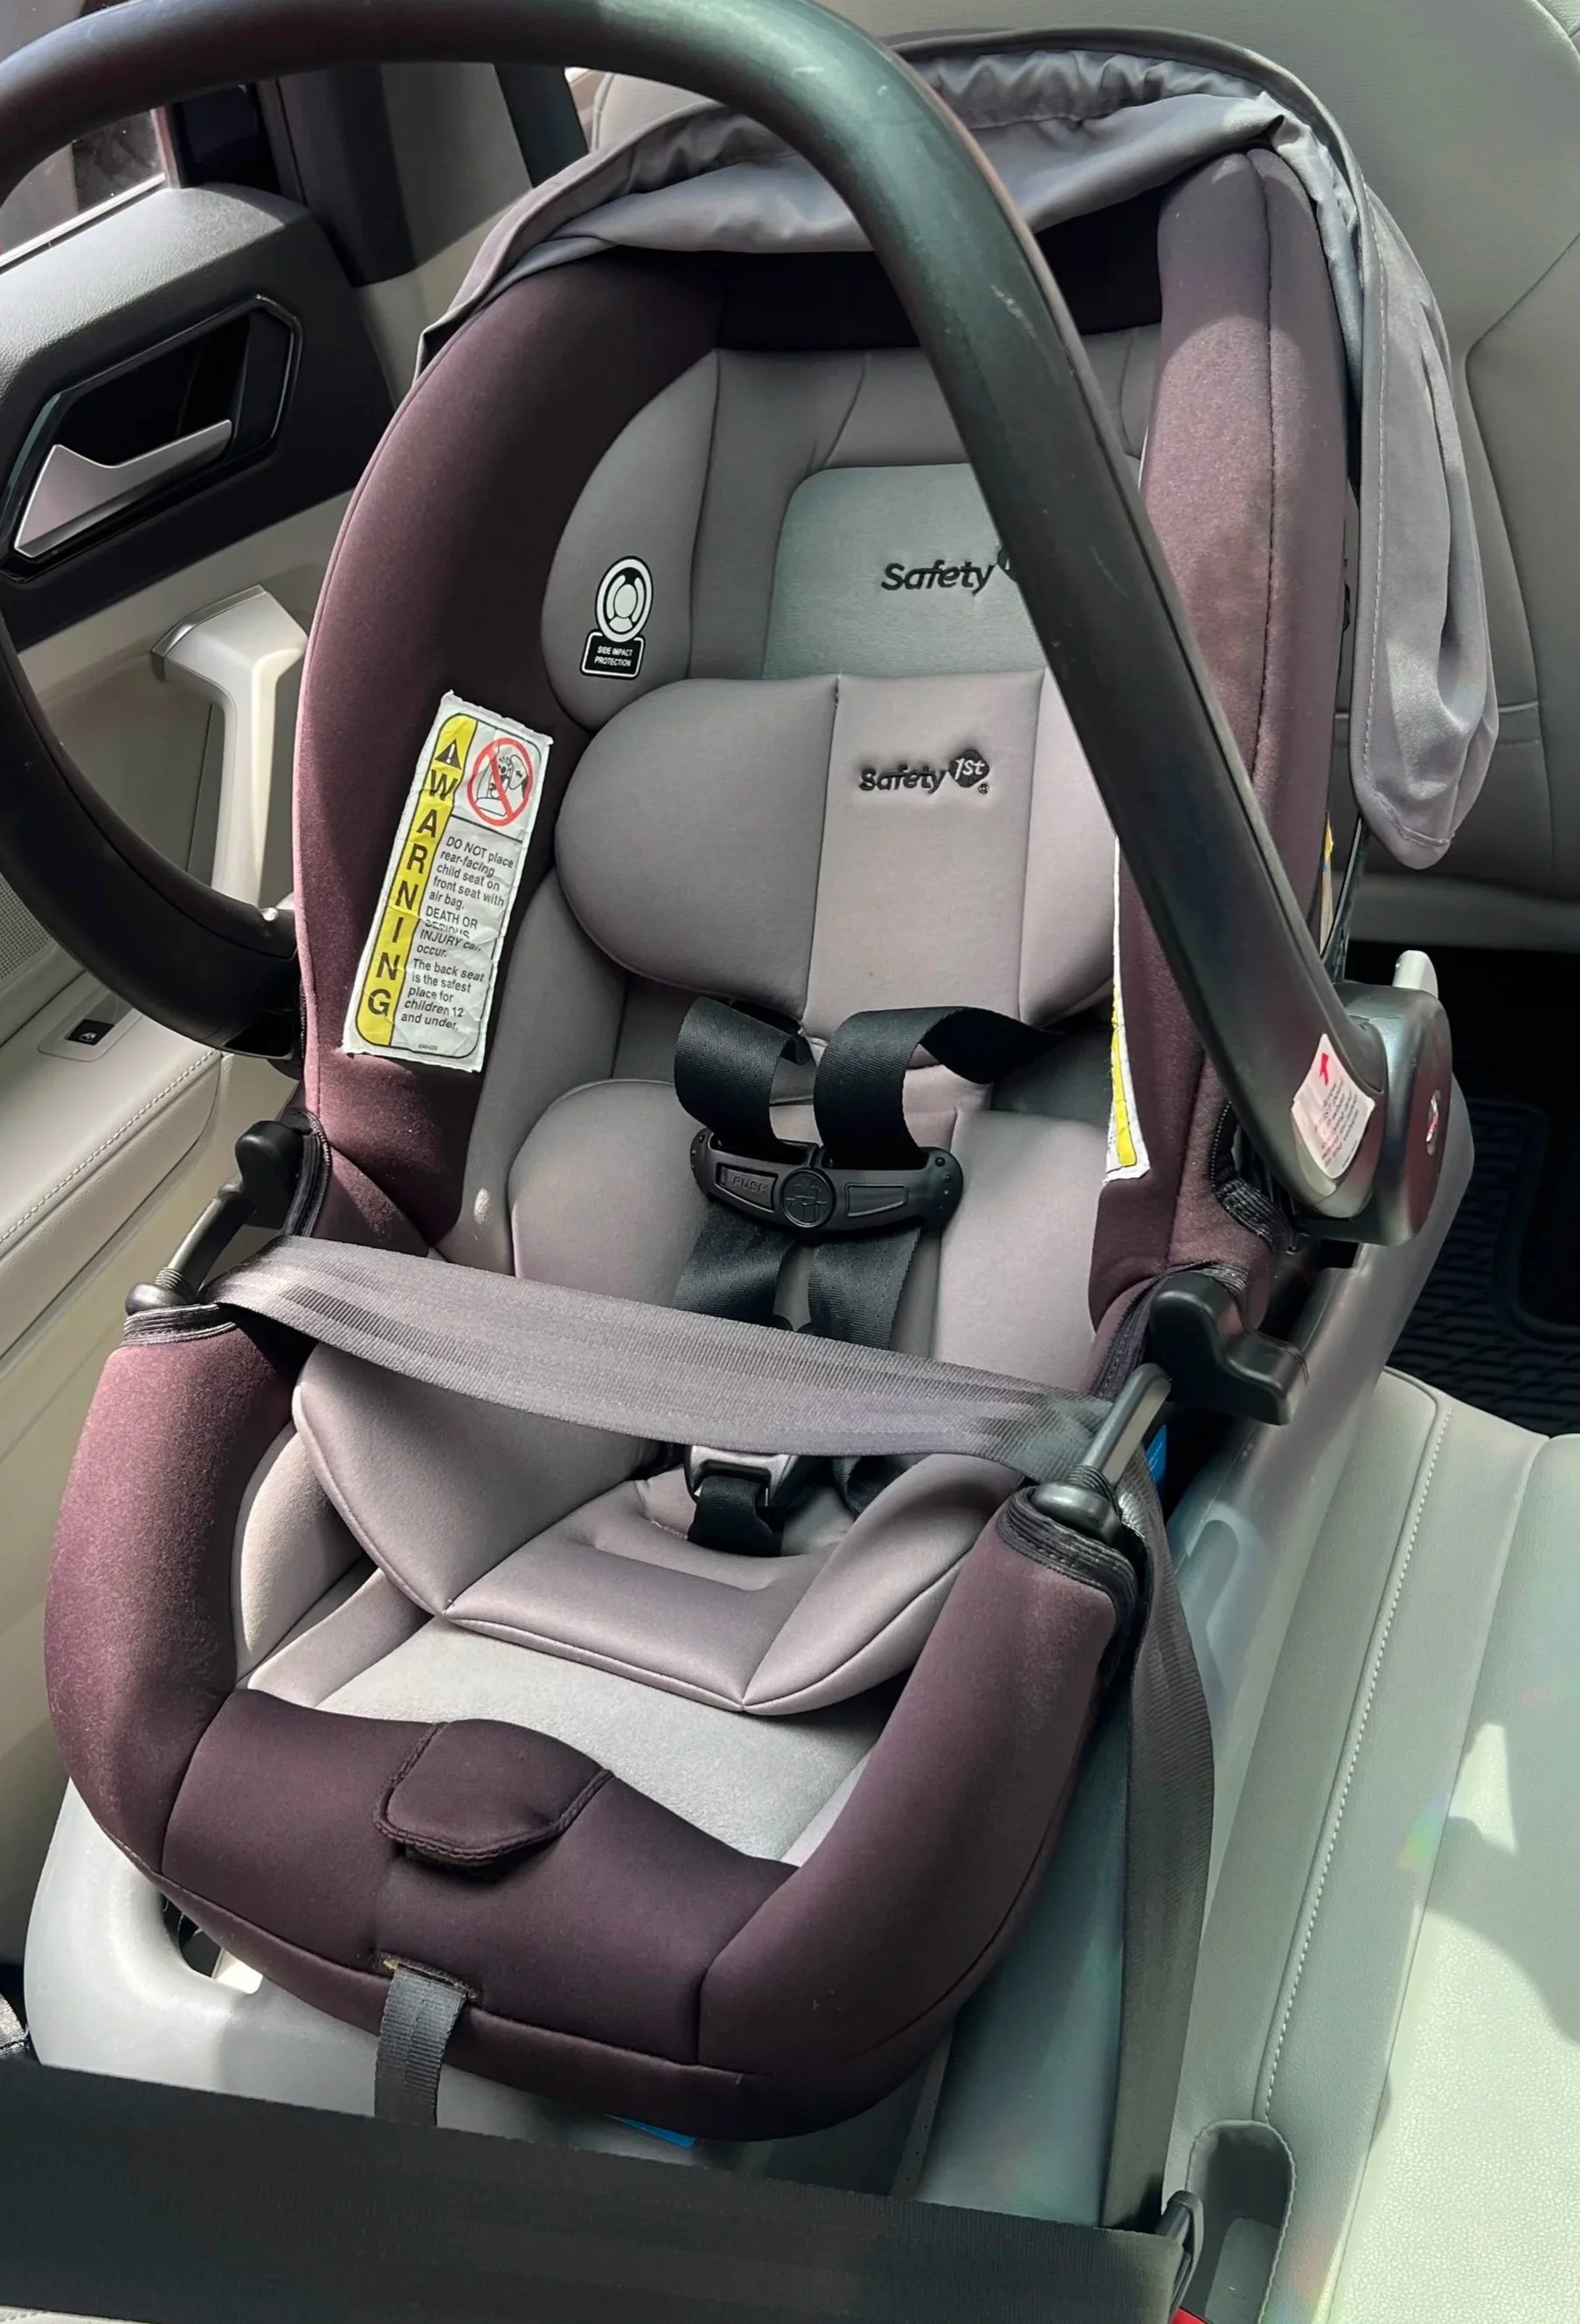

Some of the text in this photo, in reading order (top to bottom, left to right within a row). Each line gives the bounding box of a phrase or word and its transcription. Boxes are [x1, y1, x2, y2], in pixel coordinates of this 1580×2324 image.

[881, 559, 995, 596] Safety
[594, 656, 632, 667] PROTECTION
[597, 646, 634, 656] SIDE IMPACT
[859, 764, 946, 794] Safety
[447, 836, 514, 868] DO NOT place
[440, 851, 495, 878] rear-facing
[437, 864, 500, 891] child seat on
[367, 769, 458, 1016] WARNING
[429, 891, 464, 910] air bag.
[433, 876, 504, 907] front seat with
[426, 905, 478, 930] DEATH OR
[419, 929, 462, 947] INJURY
[417, 944, 447, 958] occur.
[413, 958, 485, 982] The back seat
[412, 971, 472, 993] is the safest
[407, 986, 454, 1002] place for
[401, 1013, 422, 1023] and
[405, 999, 464, 1017] children 12
